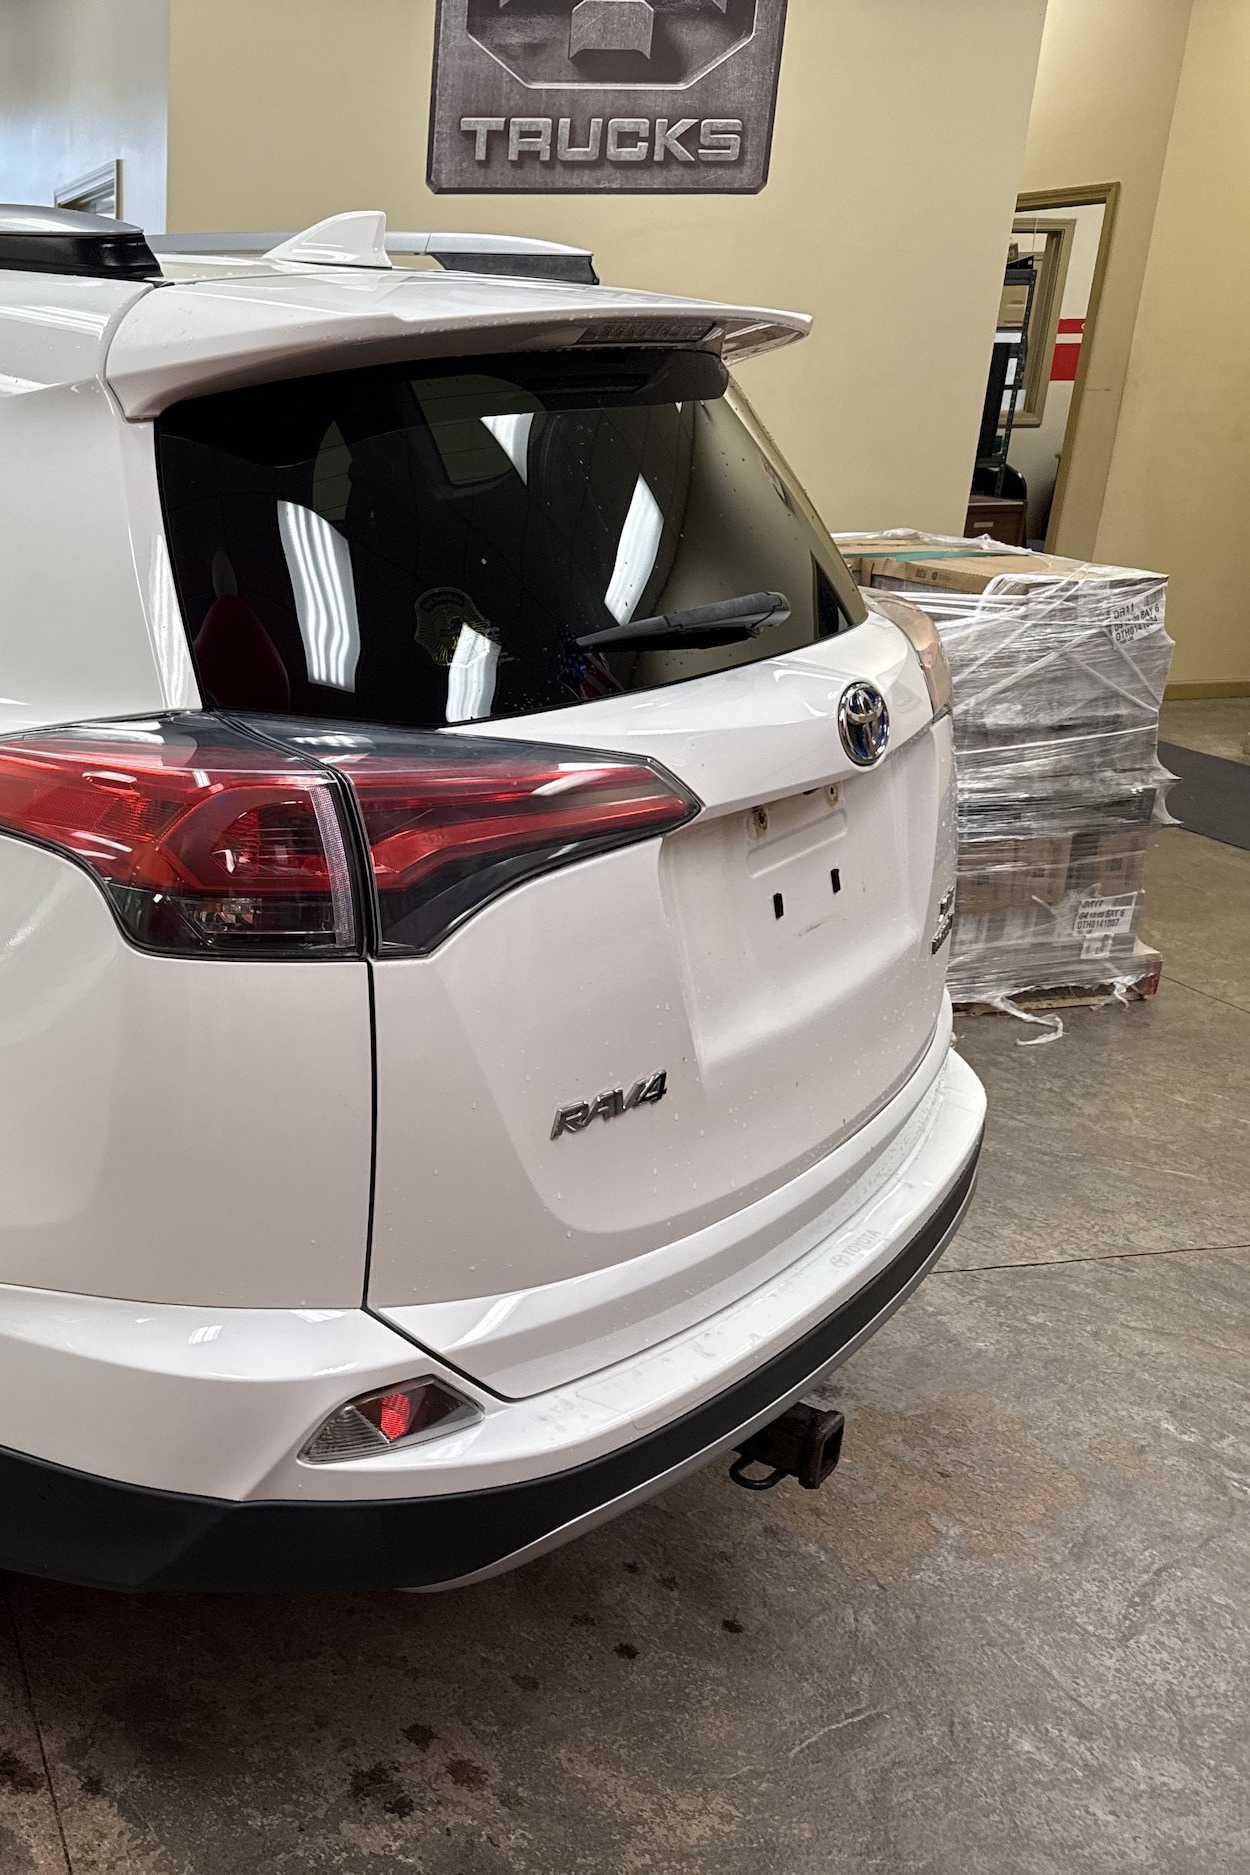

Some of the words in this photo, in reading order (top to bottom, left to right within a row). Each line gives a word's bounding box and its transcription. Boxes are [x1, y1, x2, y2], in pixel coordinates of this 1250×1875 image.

[460, 117, 743, 162] TRUCKS
[550, 1069, 667, 1140] RAV4
[842, 1230, 881, 1255] TOYOTA
